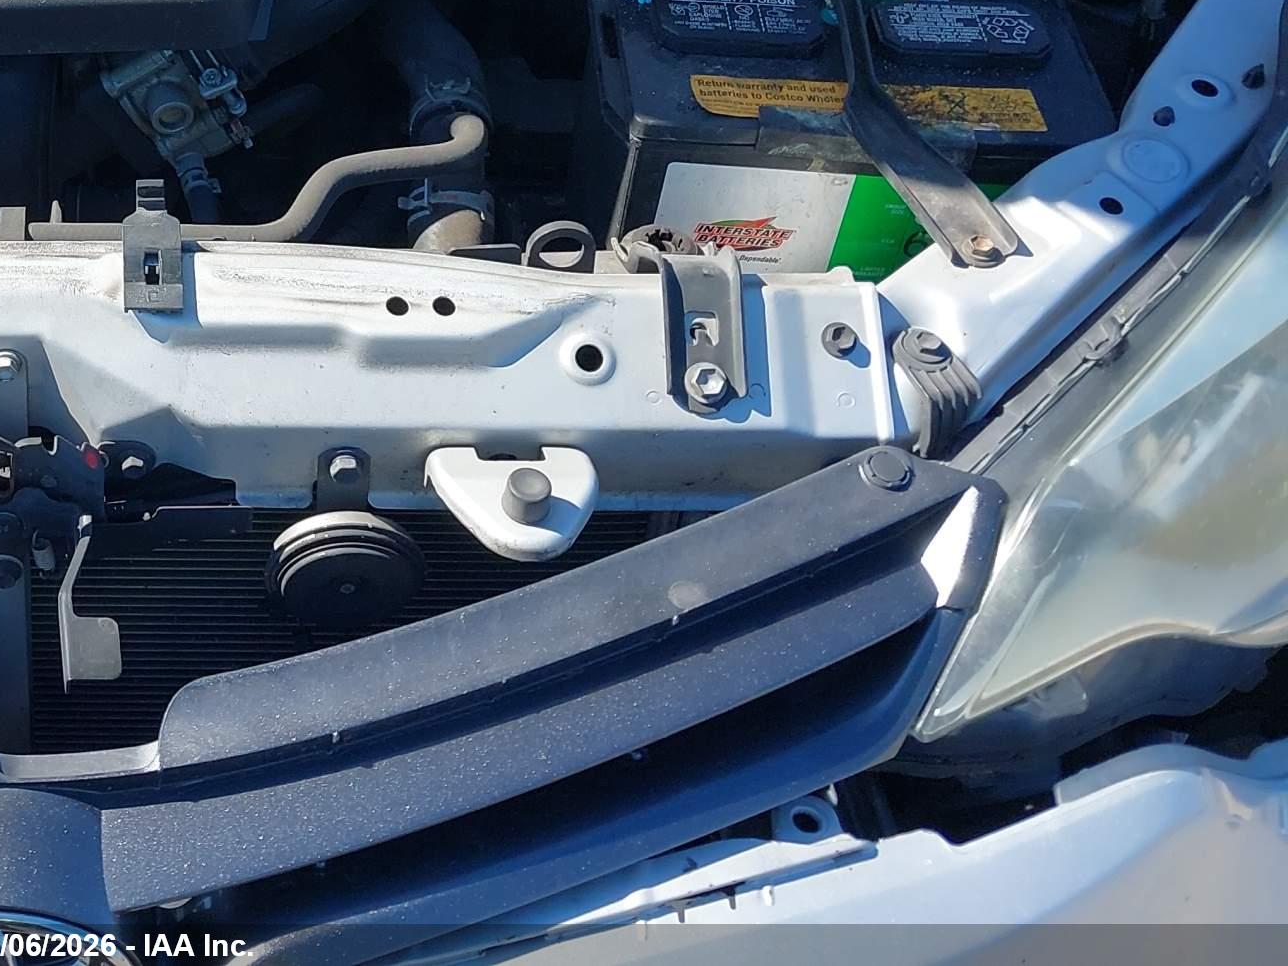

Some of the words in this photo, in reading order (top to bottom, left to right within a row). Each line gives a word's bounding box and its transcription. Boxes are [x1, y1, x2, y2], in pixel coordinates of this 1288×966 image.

[735, 81, 784, 94] warranty
[786, 84, 807, 92] and
[809, 85, 836, 94] used
[699, 88, 749, 100] batteries
[751, 91, 762, 100] to
[765, 92, 804, 102] Costco
[695, 224, 791, 240] INTERSTATE
[695, 235, 782, 247] BATTERIES
